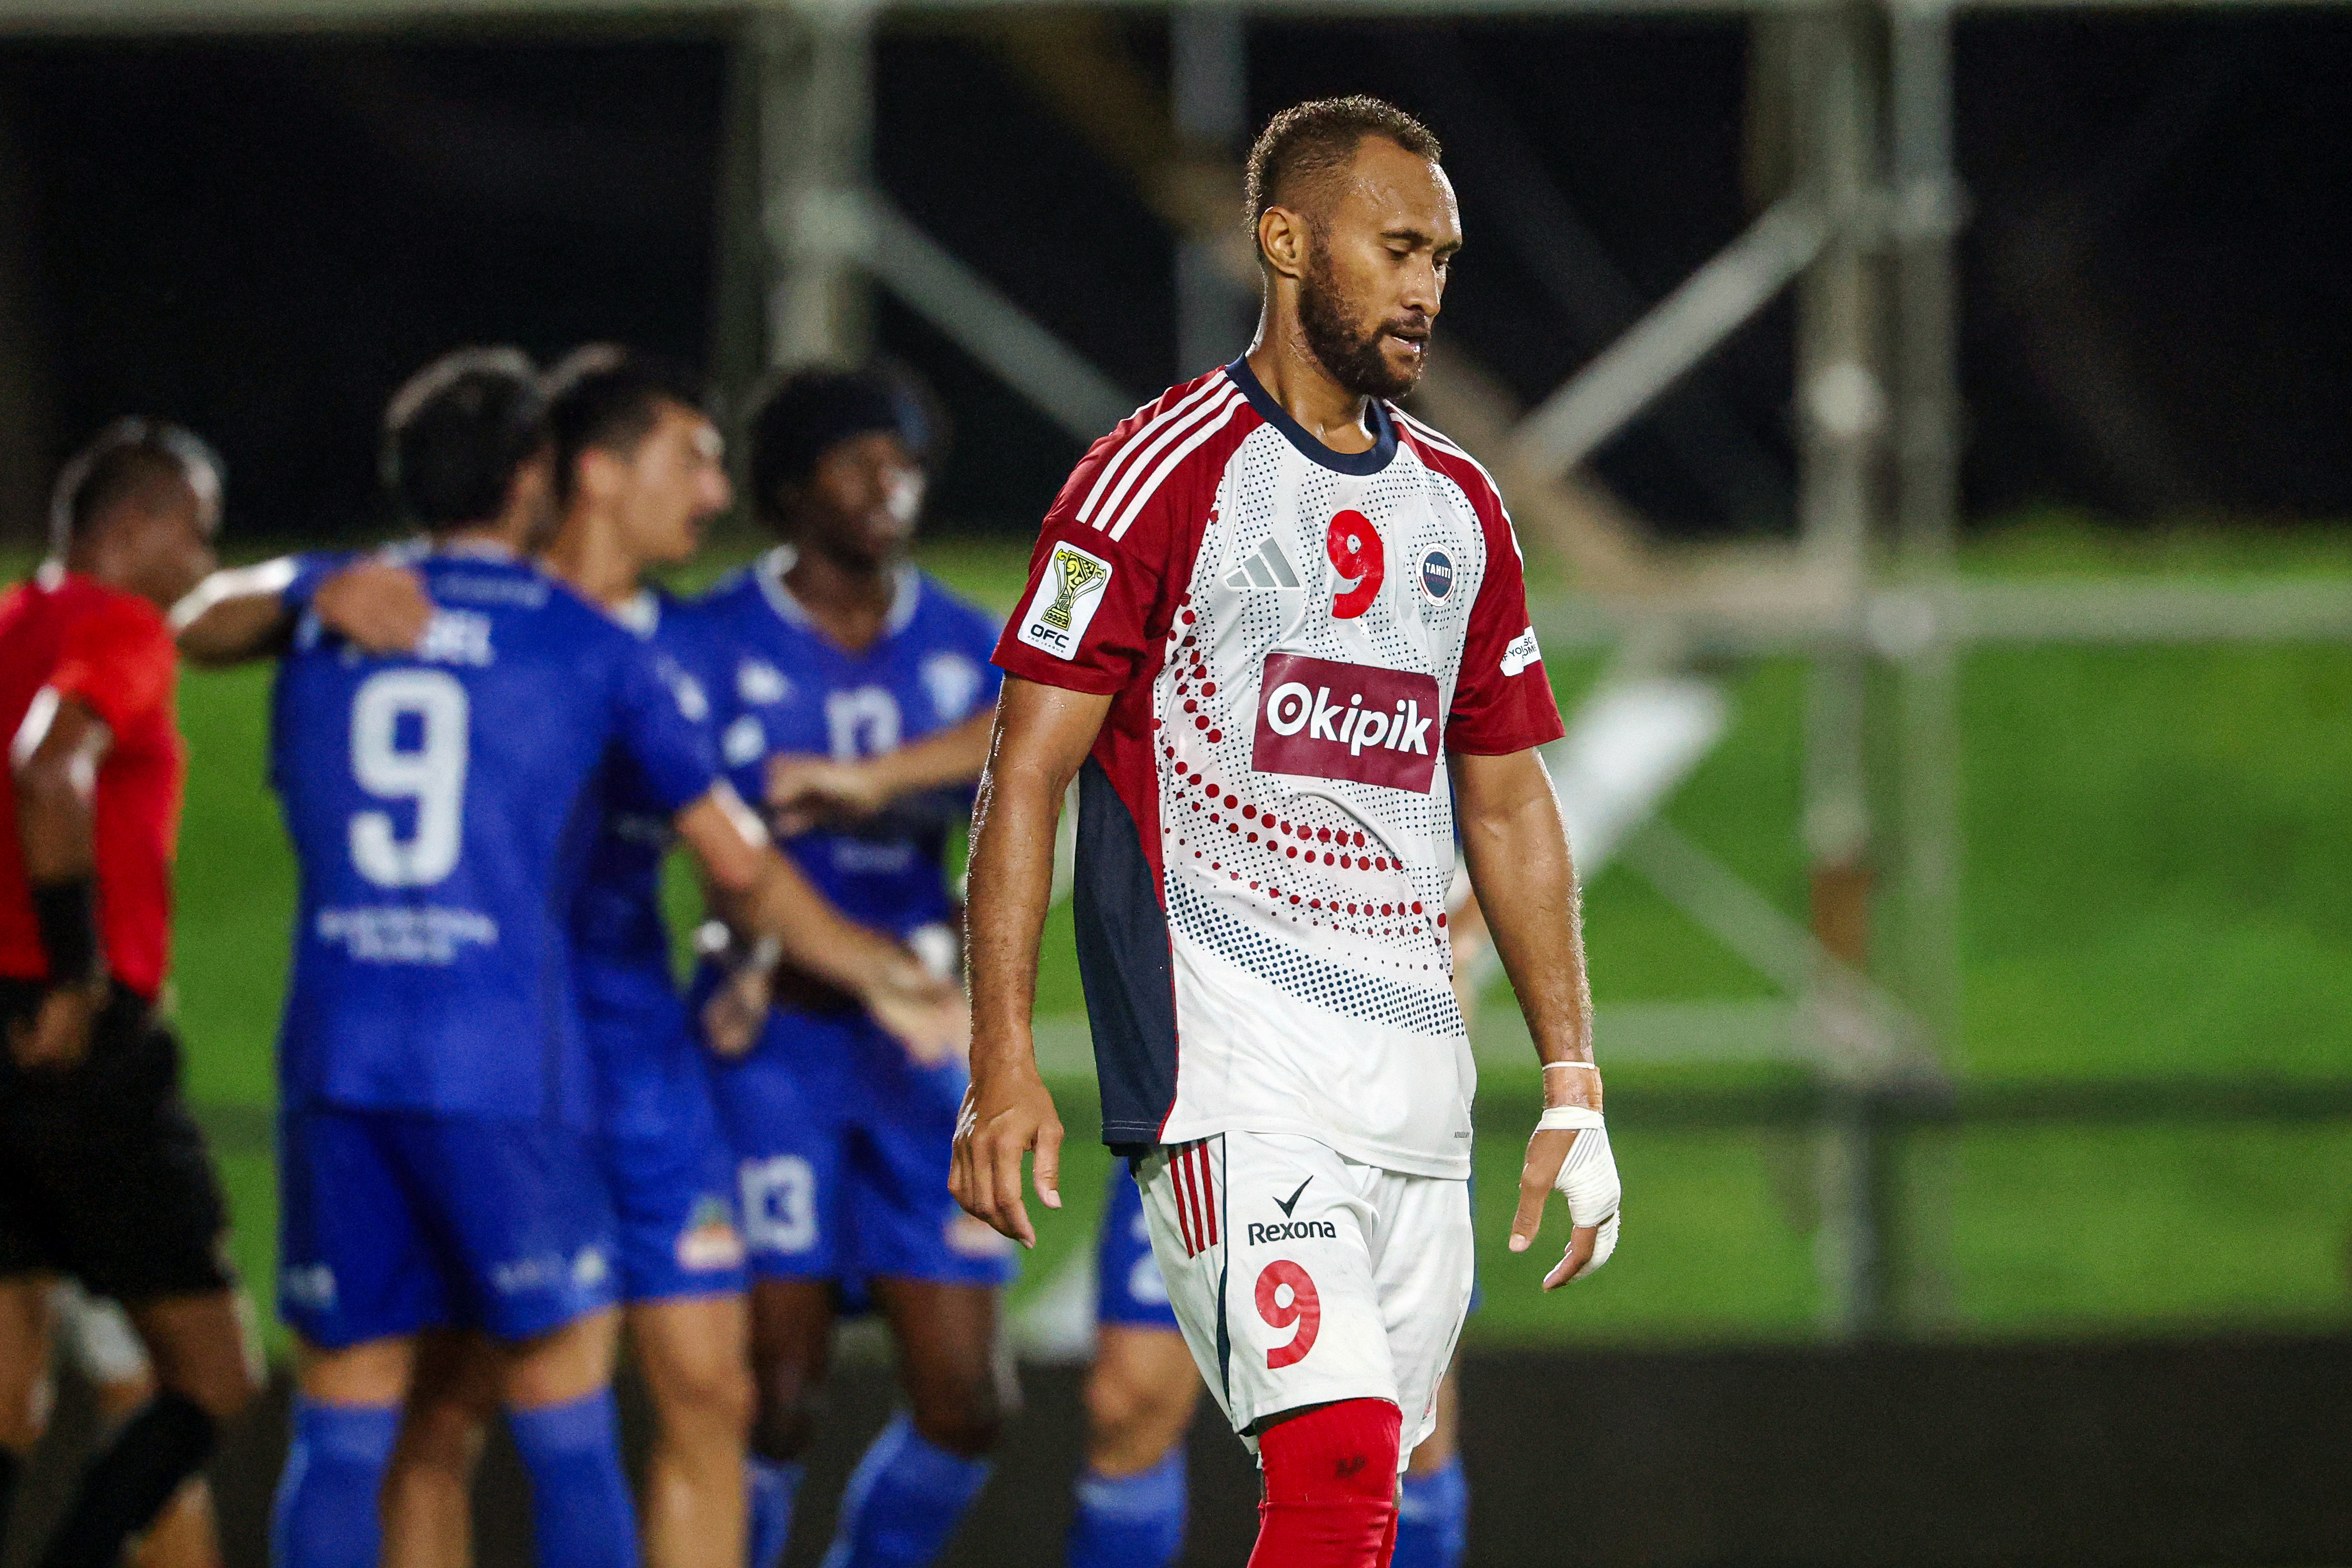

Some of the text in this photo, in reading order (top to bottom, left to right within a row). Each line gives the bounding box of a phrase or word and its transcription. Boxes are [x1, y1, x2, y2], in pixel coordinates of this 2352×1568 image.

[1327, 510, 1384, 619] 9
[1425, 562, 1451, 579] TAHITI
[1030, 624, 1070, 648] OFC
[1041, 642, 1064, 653] LEAGUE
[1267, 682, 1433, 756] Okipik
[349, 668, 470, 890] 9
[740, 1154, 816, 1251] 13
[1247, 1221, 1336, 1246] Rexona
[1255, 1260, 1321, 1369] 9
